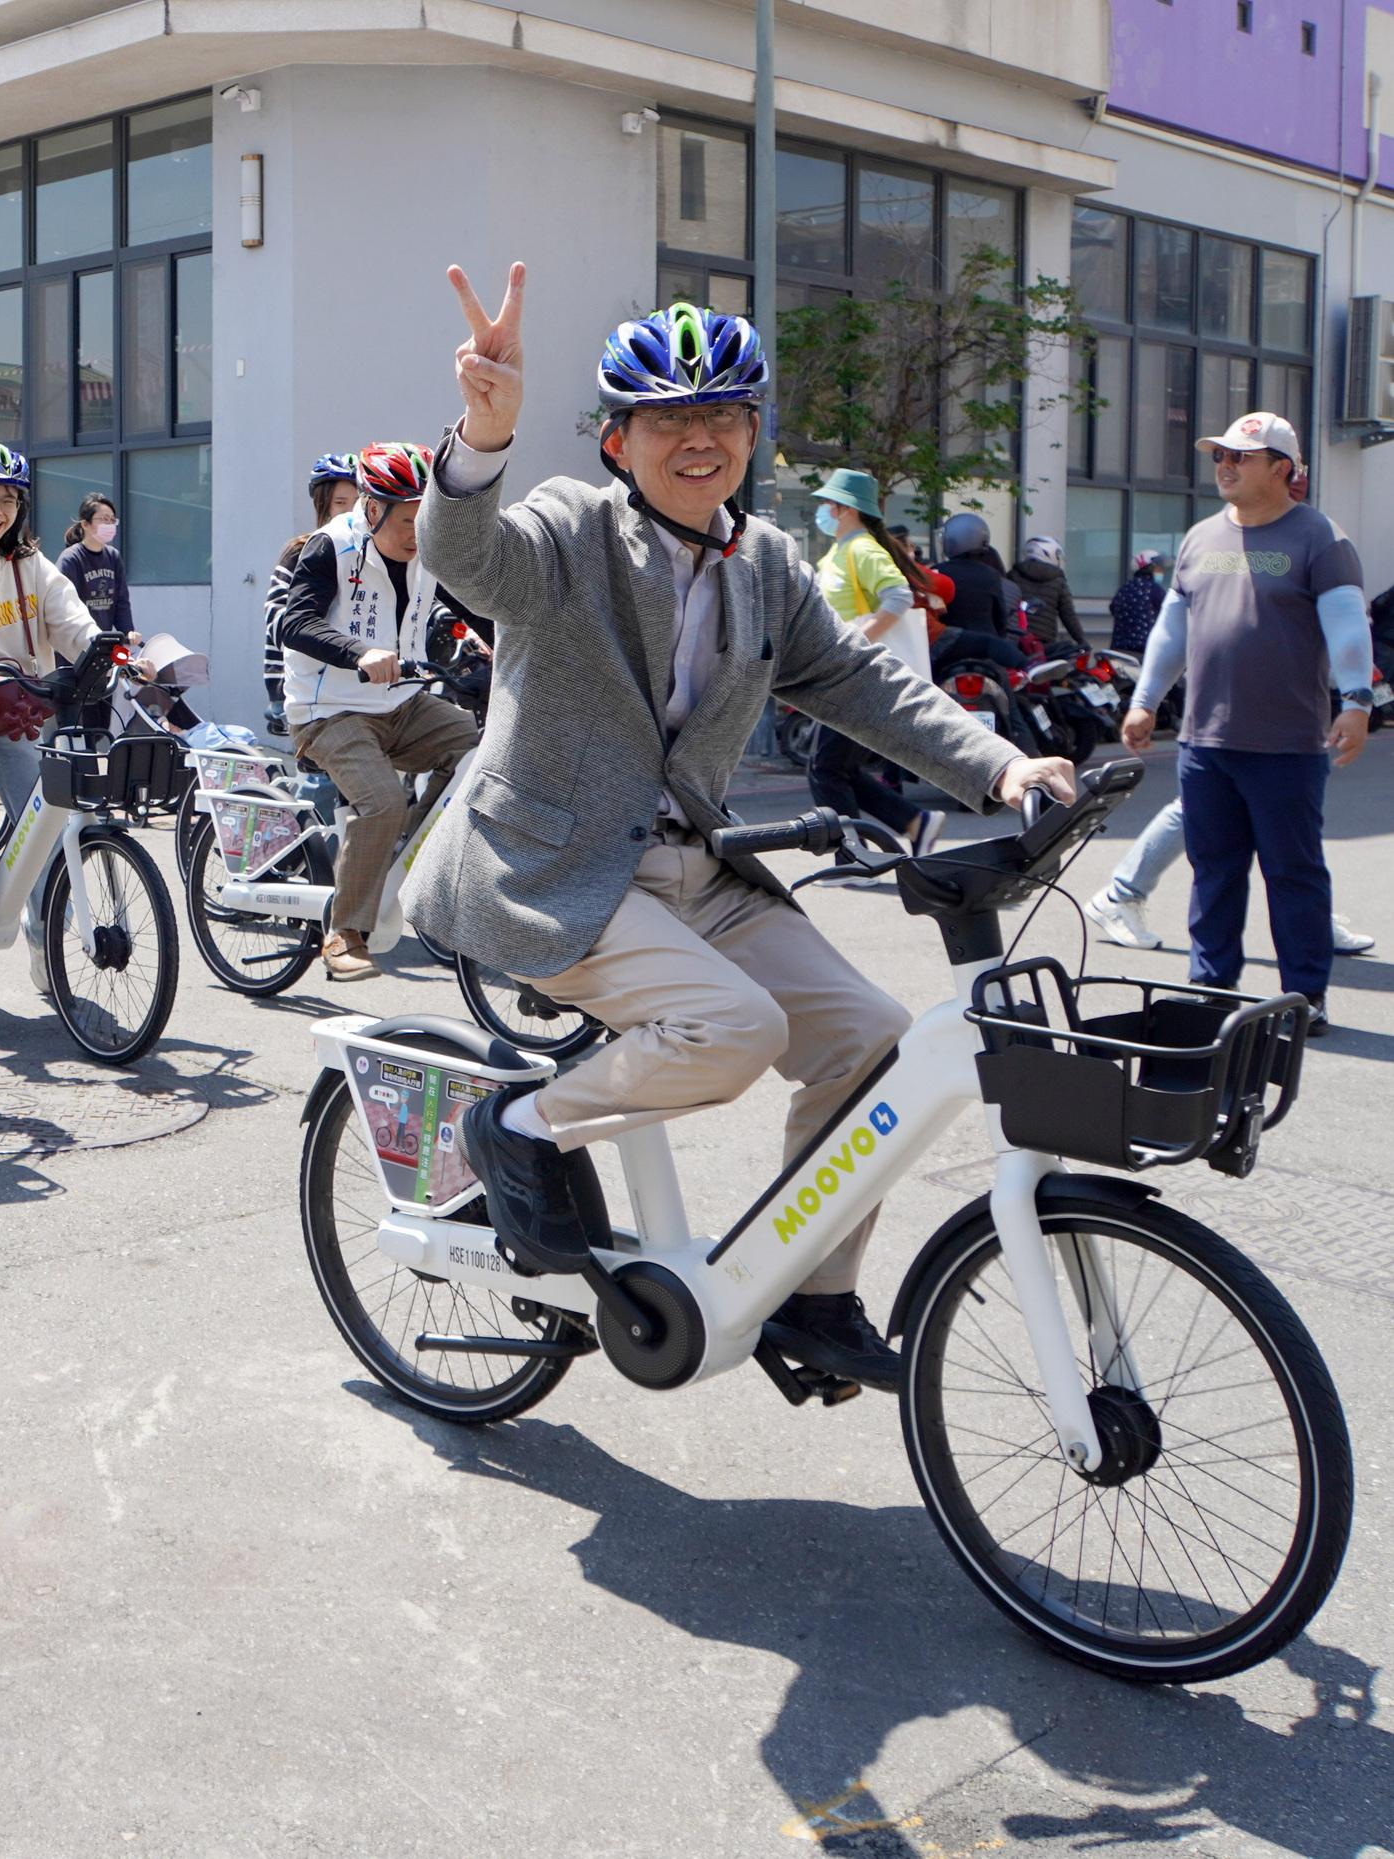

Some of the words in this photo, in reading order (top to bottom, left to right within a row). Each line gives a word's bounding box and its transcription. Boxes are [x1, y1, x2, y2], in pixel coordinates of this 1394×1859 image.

[5, 809, 36, 873] MOOVO
[772, 1126, 877, 1246] MOOVO
[449, 1245, 501, 1273] HSE1100128
